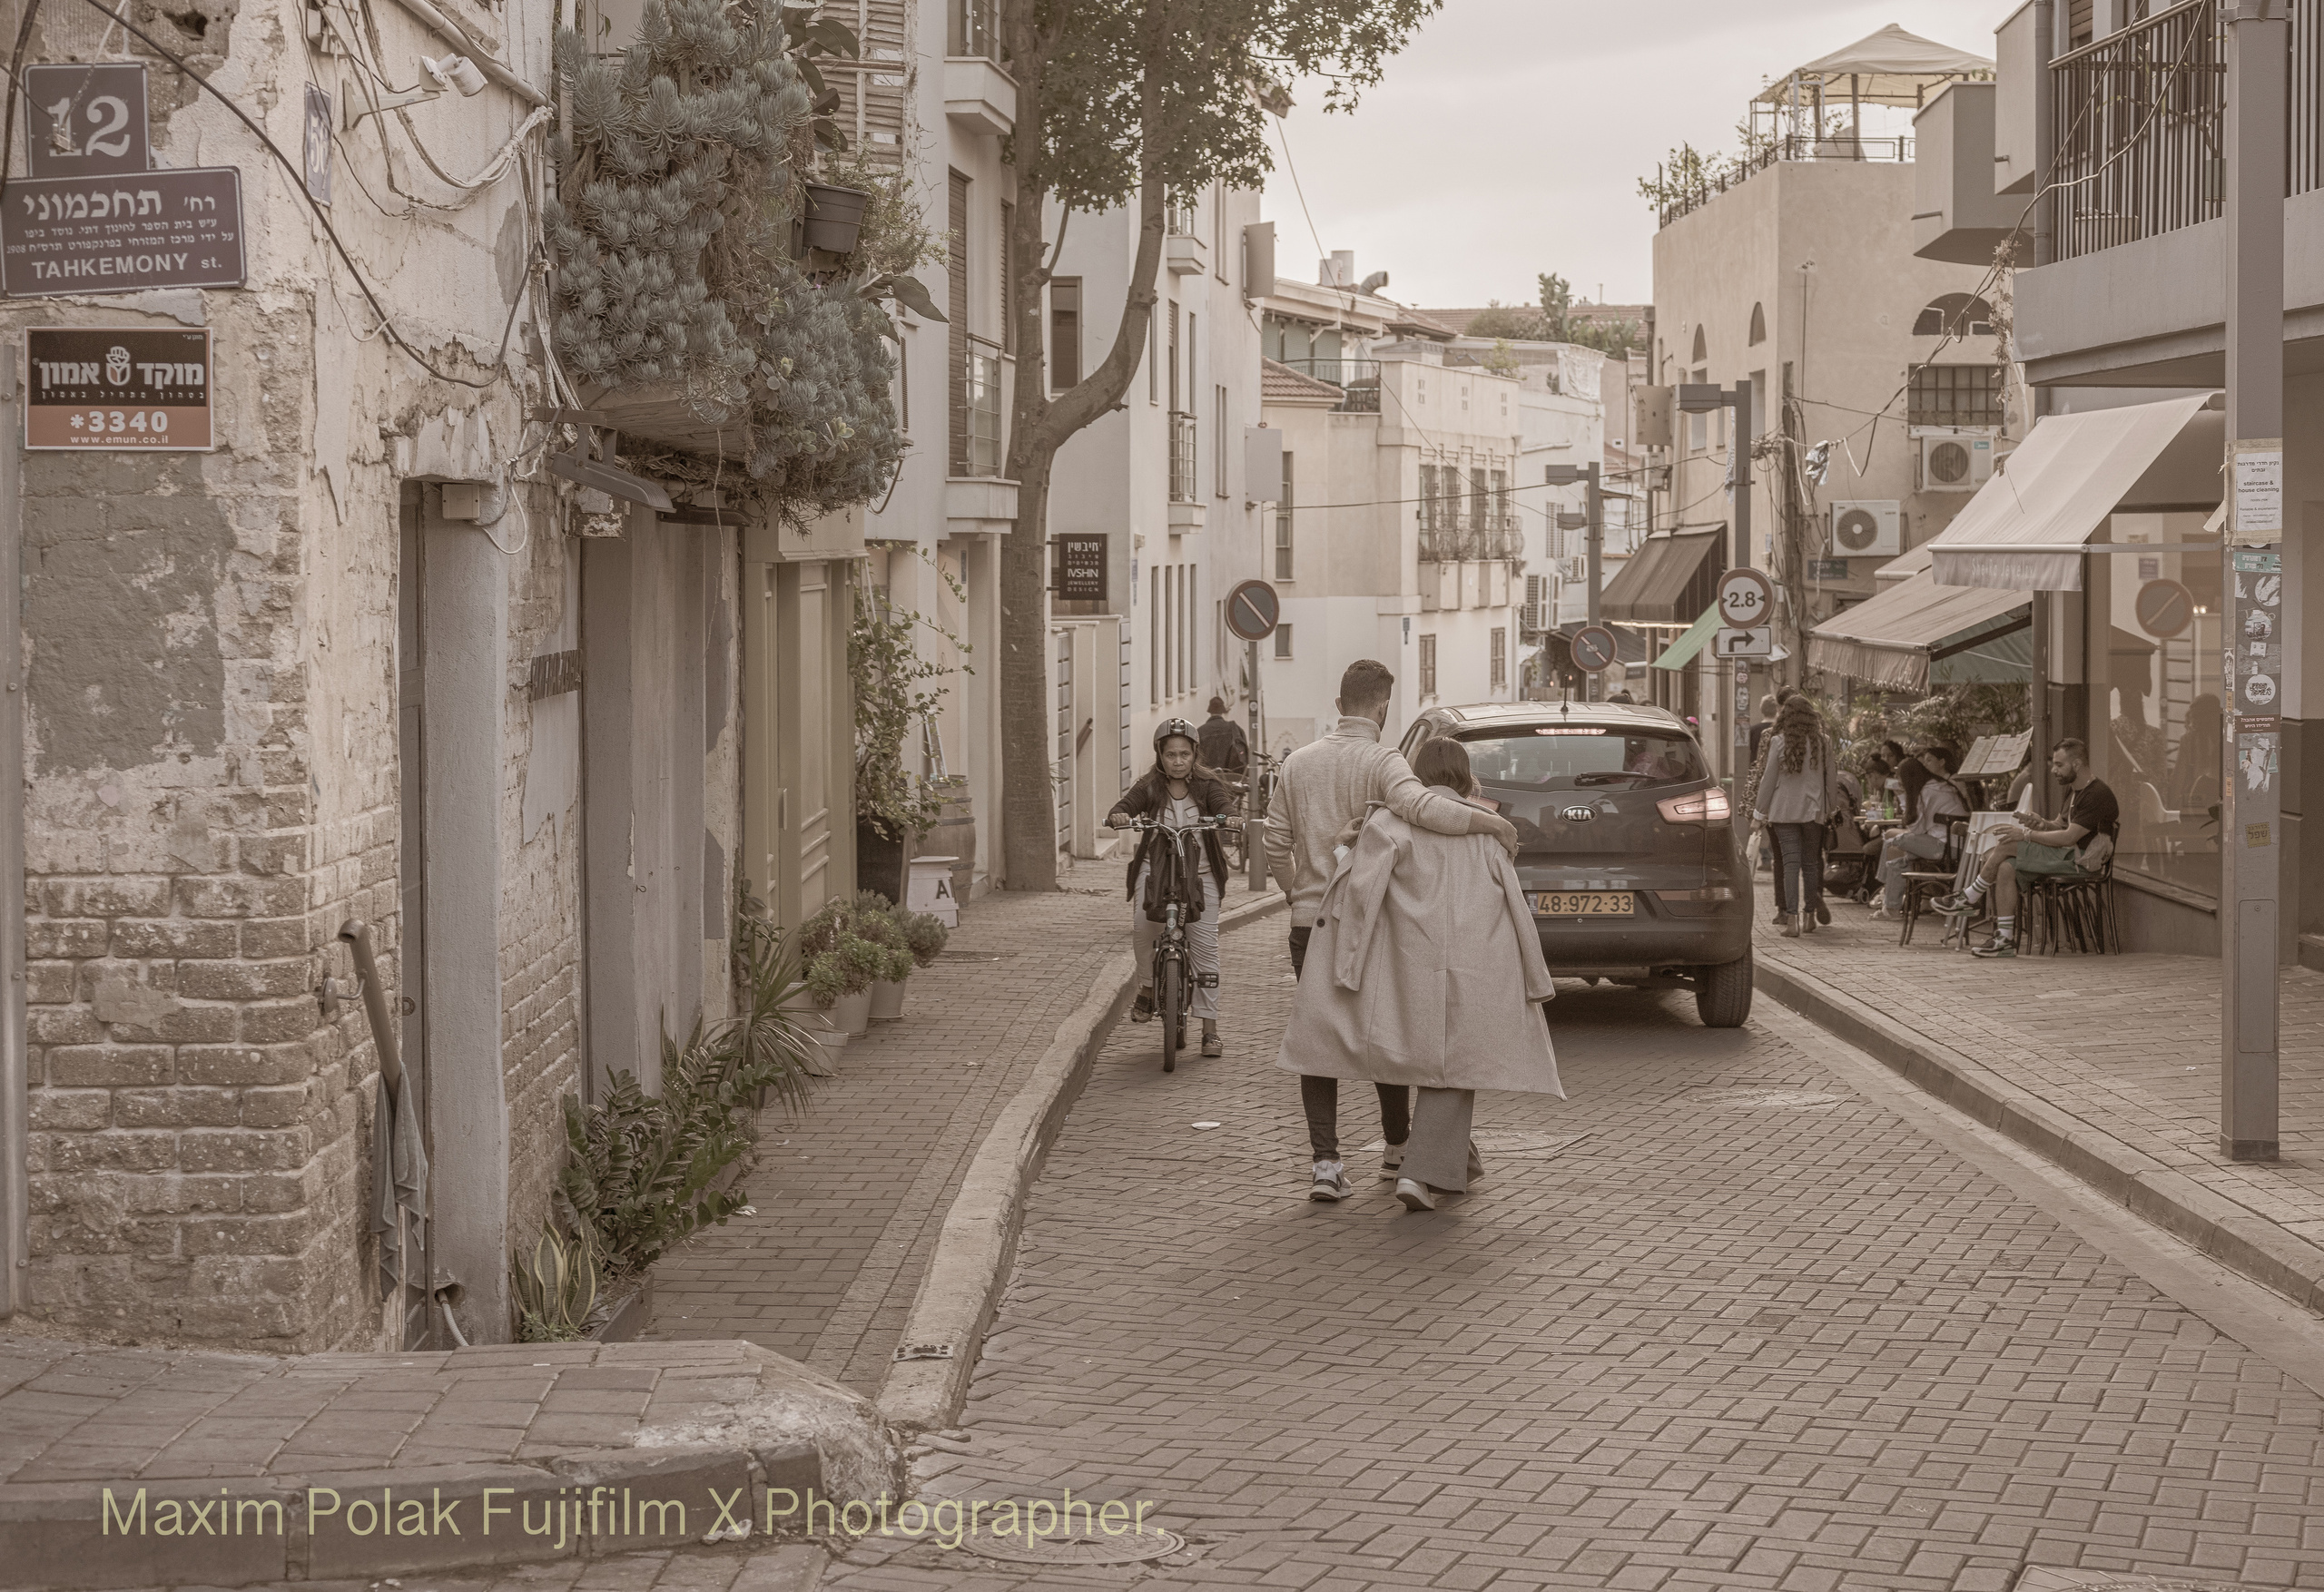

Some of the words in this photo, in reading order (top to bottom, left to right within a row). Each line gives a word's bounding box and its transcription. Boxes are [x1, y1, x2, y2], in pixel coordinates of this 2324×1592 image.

[47, 95, 131, 157] 12
[23, 189, 162, 221] תחכמוני
[183, 195, 216, 212] רח'
[105, 221, 136, 235] לחינוך
[142, 221, 170, 231] הספר
[174, 220, 193, 230] בית
[24, 229, 45, 239] ביפו
[51, 227, 73, 237] נוסד
[201, 232, 216, 243] ידי
[221, 231, 234, 242] על
[68, 238, 122, 251] בפרנקפורט
[128, 235, 165, 246] המזרחי
[171, 234, 195, 244] מרכז
[32, 252, 188, 280] TAHKEMONY
[201, 257, 222, 269] st.
[39, 362, 100, 389] אמון
[136, 362, 204, 389] מוקד
[70, 435, 169, 444] www.emun.co.il
[1729, 591, 1756, 608] 2.8
[1567, 808, 1592, 820] KIA
[2248, 830, 2268, 840] שפל
[936, 880, 950, 899] A
